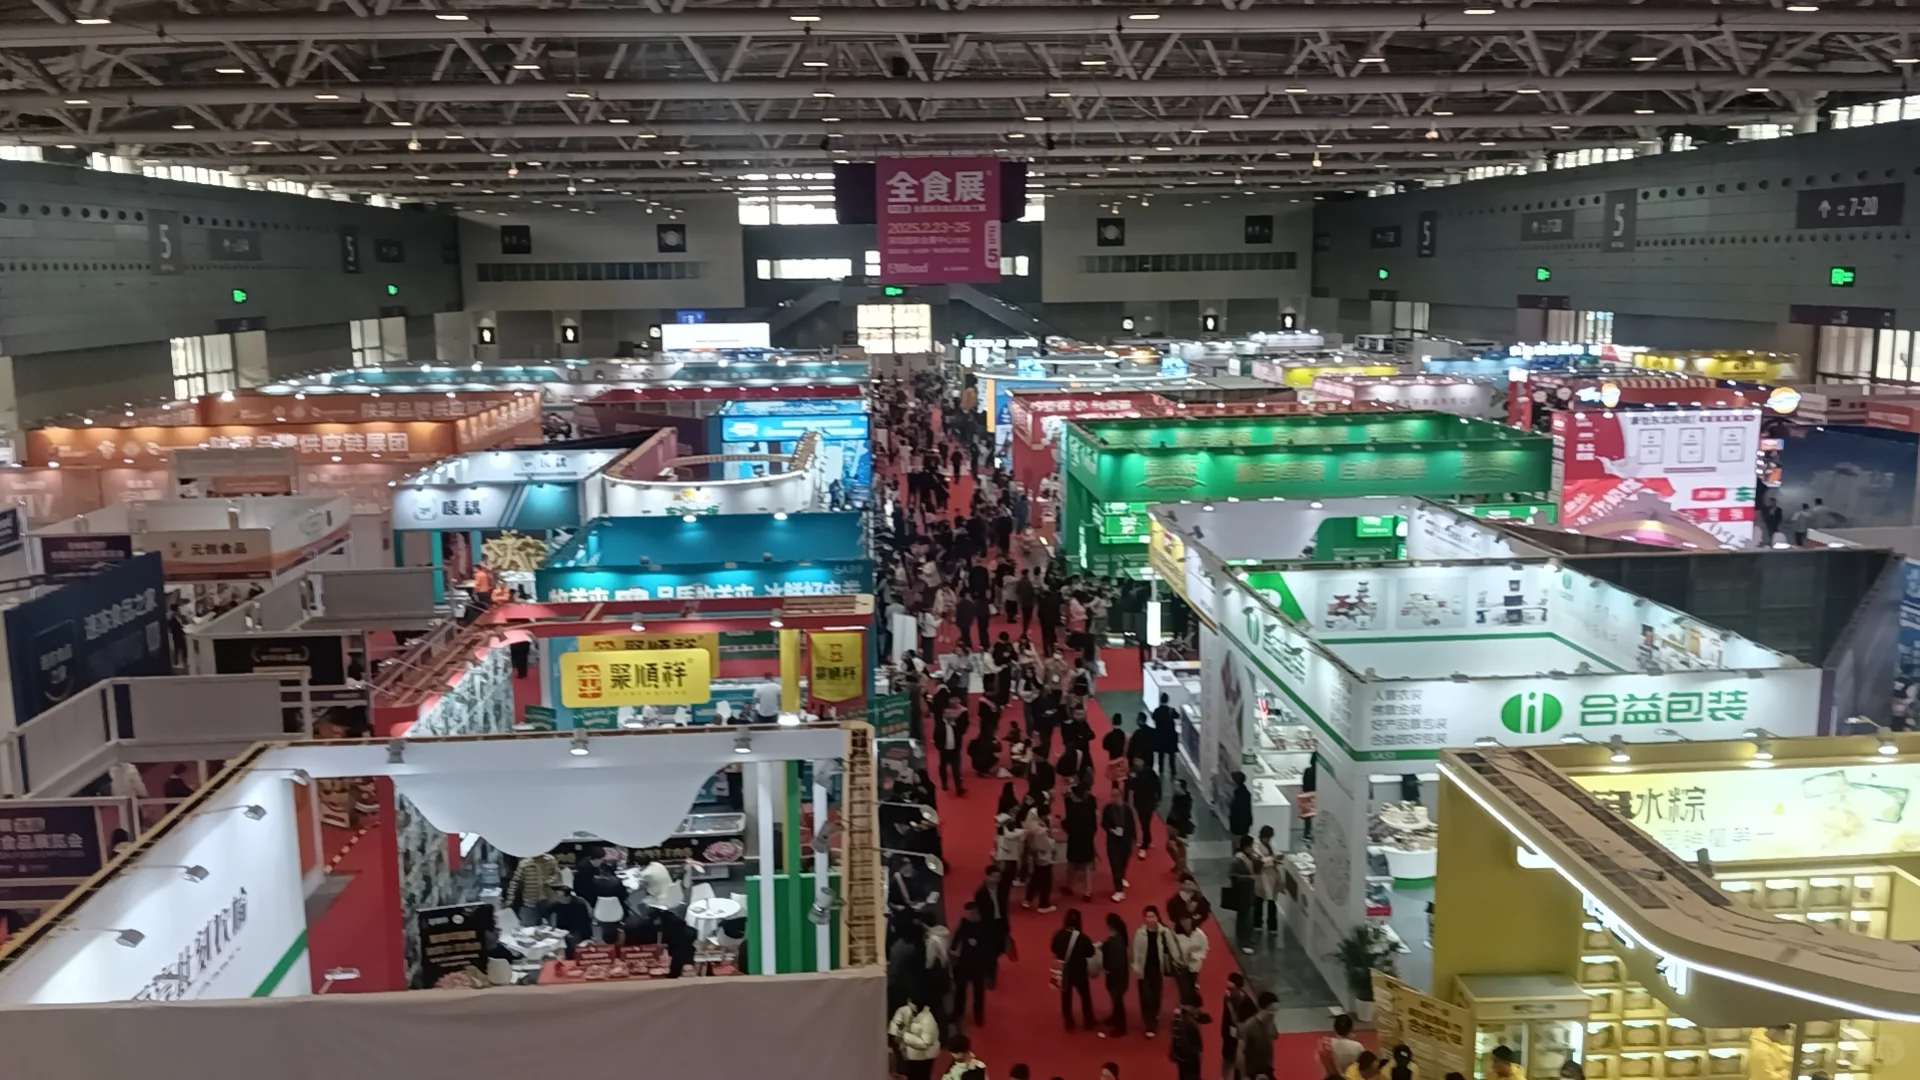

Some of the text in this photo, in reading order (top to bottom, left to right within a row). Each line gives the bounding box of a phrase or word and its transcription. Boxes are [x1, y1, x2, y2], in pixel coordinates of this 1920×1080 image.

[886, 170, 986, 203] 全食展
[888, 221, 971, 234] 2025.2.23-25
[1422, 221, 1431, 246] 5
[1613, 203, 1625, 236] 5
[159, 224, 172, 259] 5
[1580, 690, 1748, 727] 合益包装
